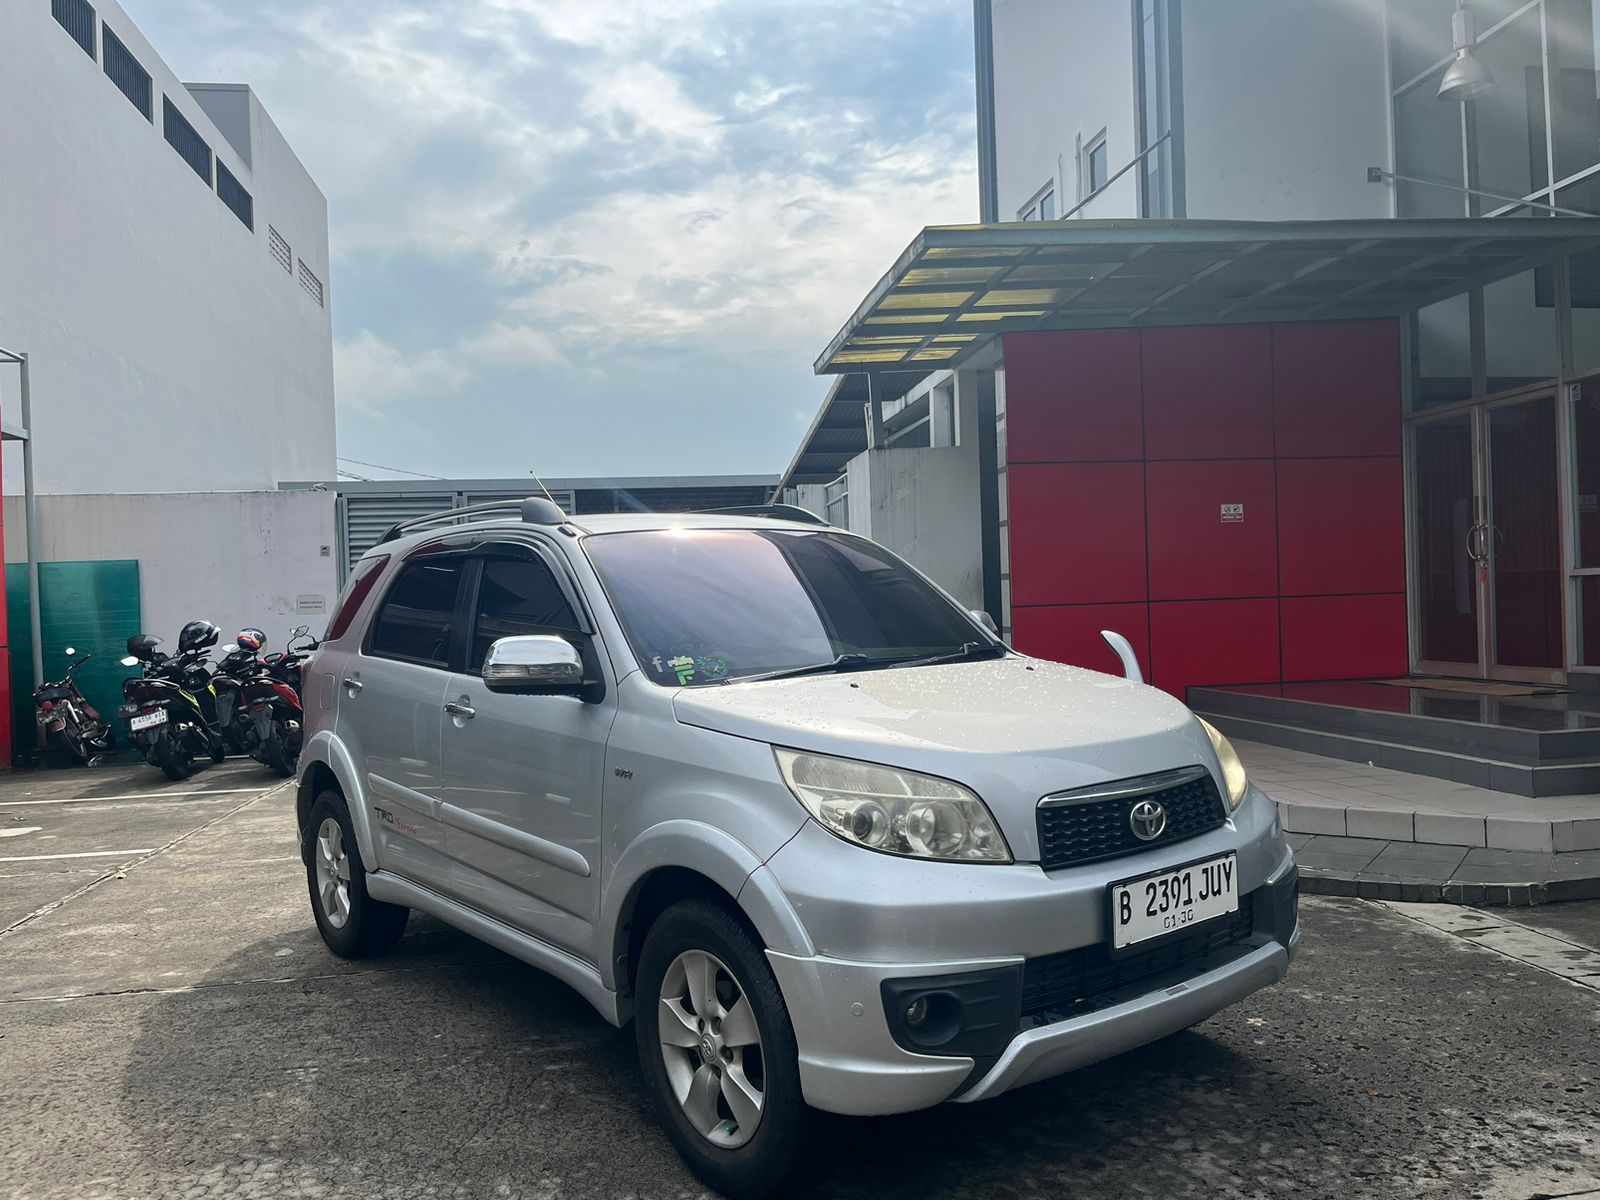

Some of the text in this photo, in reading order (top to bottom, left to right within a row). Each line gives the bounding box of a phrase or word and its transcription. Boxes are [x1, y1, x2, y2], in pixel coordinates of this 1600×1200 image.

[374, 807, 394, 824] TRD
[1120, 860, 1233, 925] B 2391 JUY
